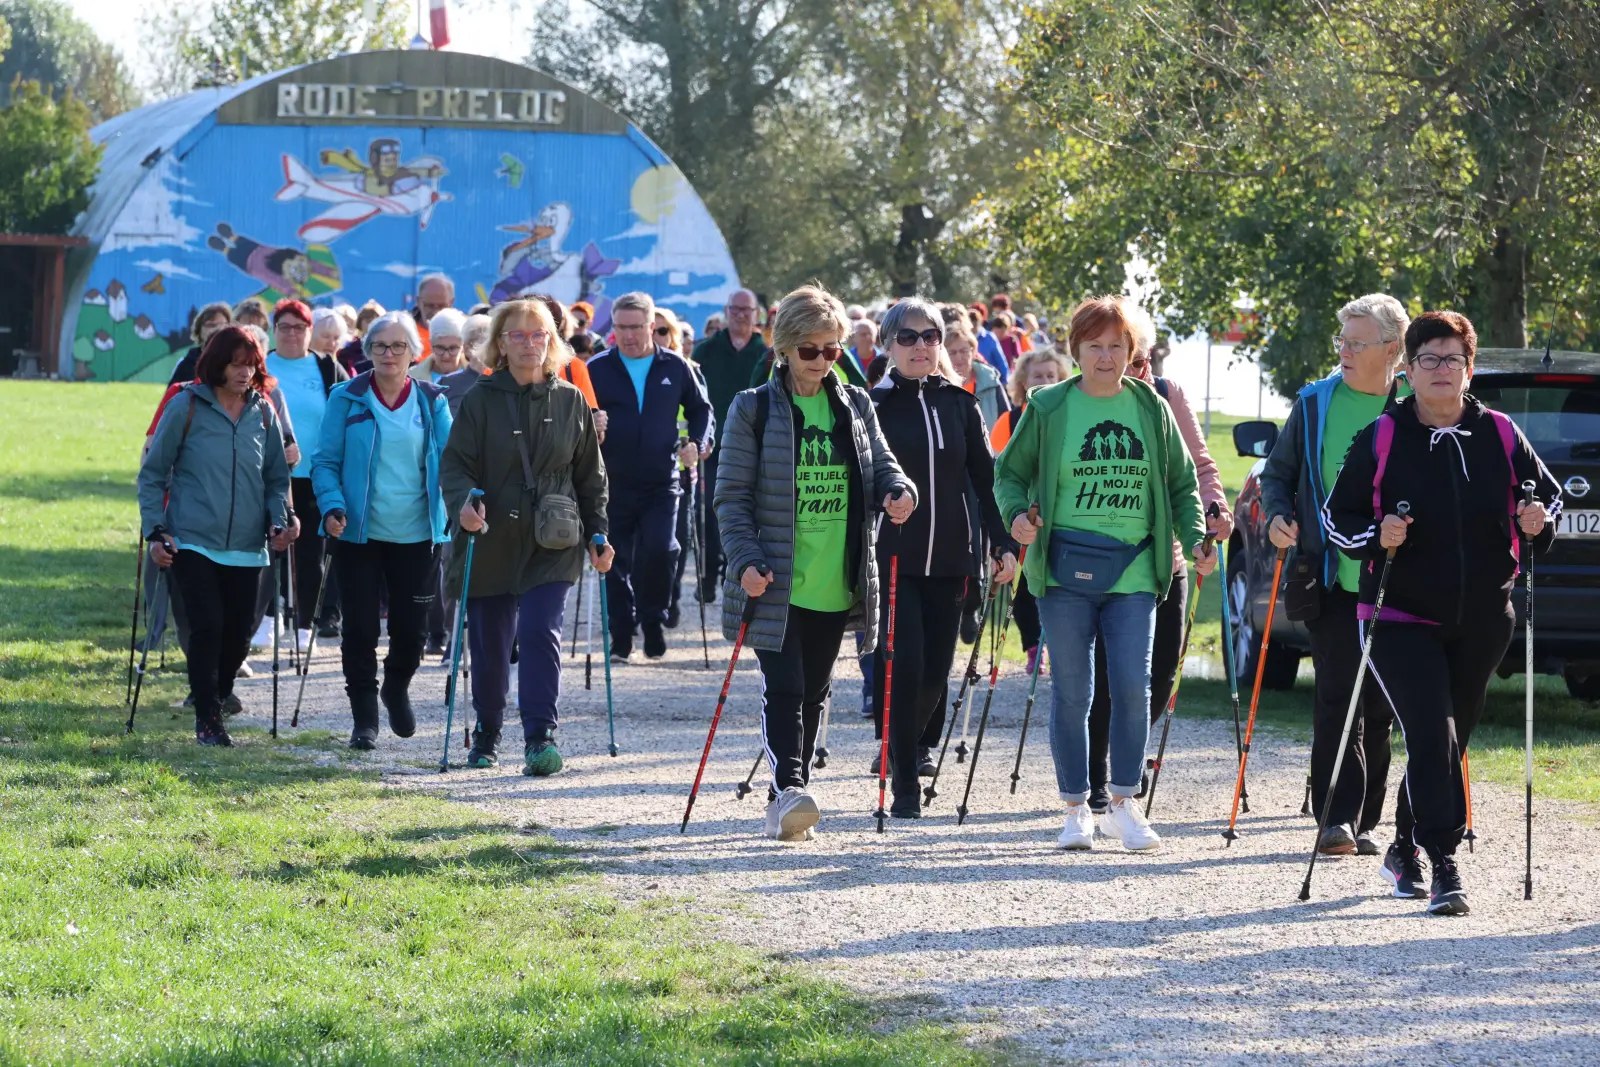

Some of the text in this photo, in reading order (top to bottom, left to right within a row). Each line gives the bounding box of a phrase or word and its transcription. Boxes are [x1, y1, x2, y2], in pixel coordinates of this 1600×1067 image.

[277, 83, 566, 124] RODE PRELOG
[1073, 465, 1148, 477] MOJE TIJELO
[805, 484, 845, 494] MOJ JE
[1103, 479, 1143, 490] MOJ JE
[1075, 481, 1143, 510] Hram
[797, 497, 847, 514] ram
[1567, 513, 1600, 533] 102
